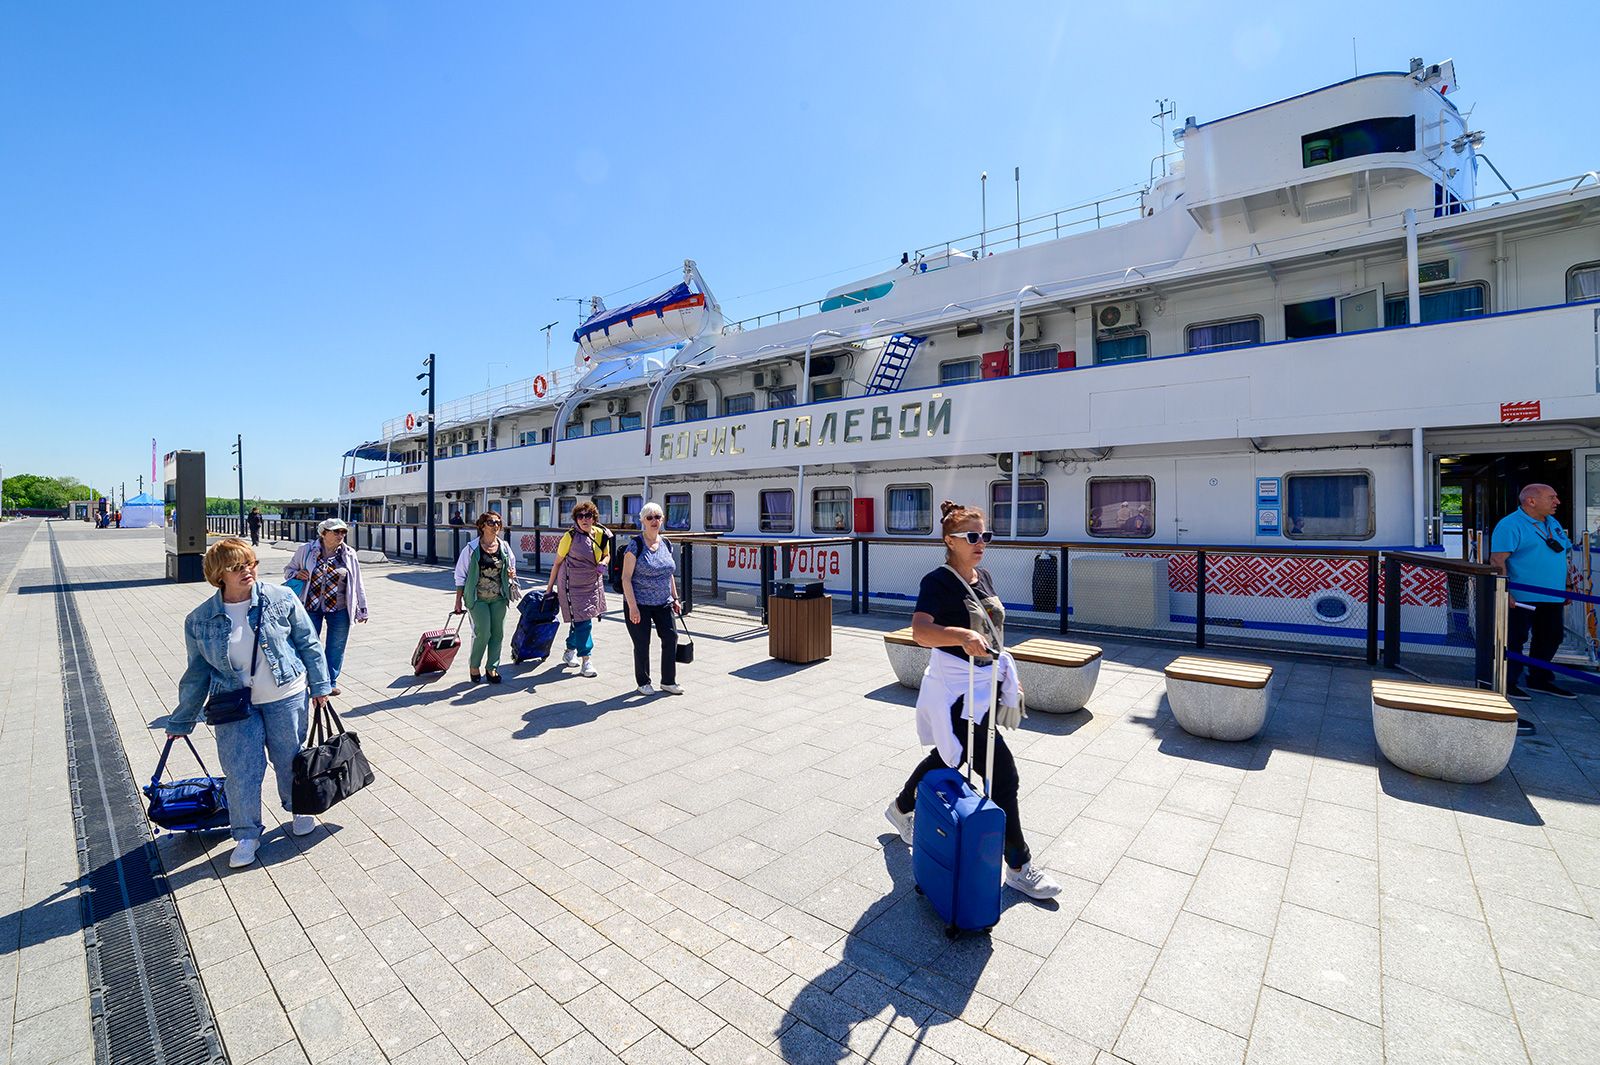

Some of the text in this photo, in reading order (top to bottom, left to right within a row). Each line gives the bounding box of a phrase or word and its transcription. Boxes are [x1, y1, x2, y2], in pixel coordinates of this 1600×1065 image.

[660, 393, 952, 461] БОРИС ПОЛЕВОЙ
[727, 543, 777, 571] Вол
